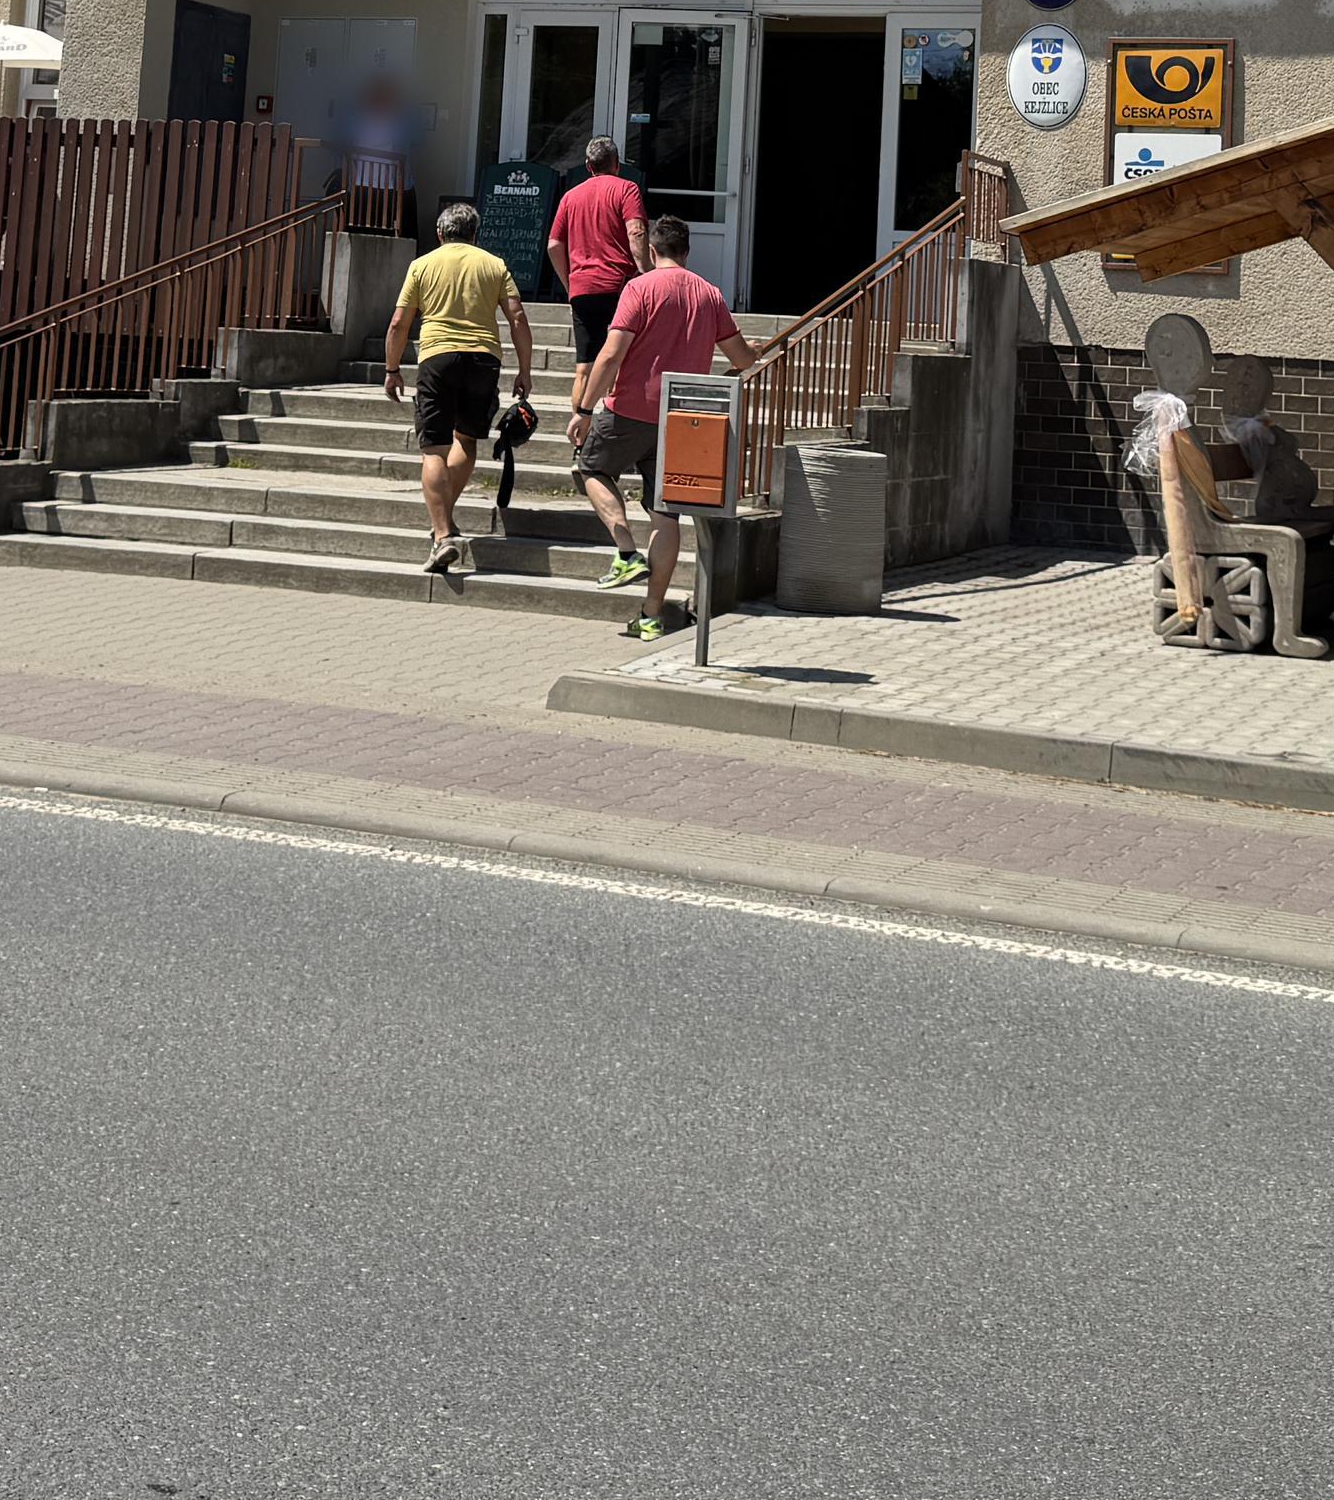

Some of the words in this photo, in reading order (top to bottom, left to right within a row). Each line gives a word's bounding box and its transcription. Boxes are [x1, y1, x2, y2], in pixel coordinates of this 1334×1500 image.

[1032, 82, 1059, 95] OBEC
[1024, 97, 1069, 115] KEJŽLICE
[1121, 104, 1166, 119] ČESKÁ
[1169, 105, 1213, 120] POŠTA
[1124, 167, 1162, 180] ČSO
[493, 184, 540, 196] BERNARD
